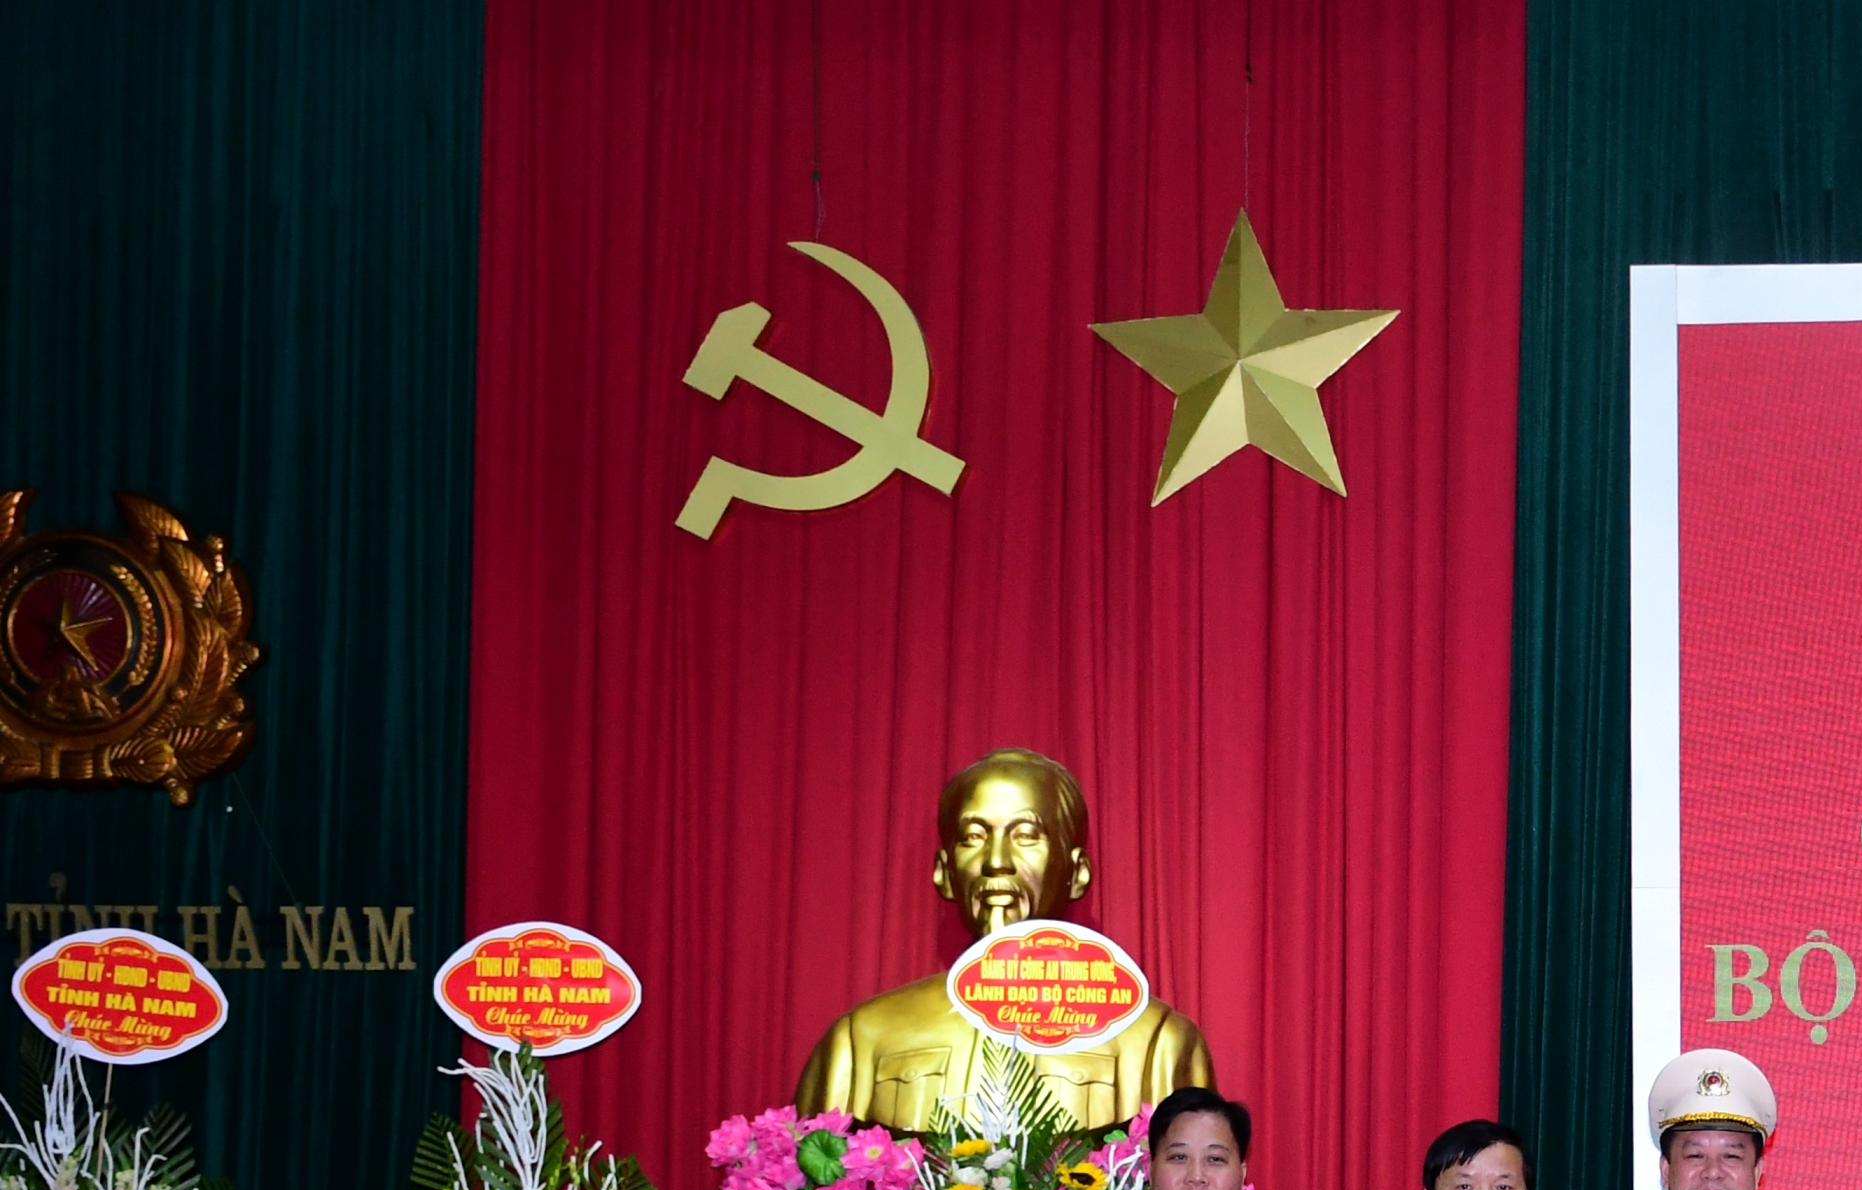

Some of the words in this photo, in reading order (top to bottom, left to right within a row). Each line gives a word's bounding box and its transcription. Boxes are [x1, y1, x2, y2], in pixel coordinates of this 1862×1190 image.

[177, 885, 266, 969] HÀ
[280, 906, 416, 970] NAM
[1020, 956, 1045, 981] CÔNG
[1046, 959, 1060, 981] AN
[1061, 960, 1089, 982] TRUNG
[467, 981, 518, 1003] TỈNH
[523, 984, 553, 1003] HÀ
[559, 987, 611, 1004] NAM
[965, 984, 1004, 1002] LÃNH
[1007, 985, 1038, 1005] ĐẠO
[1042, 984, 1062, 1007] BỘ
[1065, 984, 1107, 1004] CÔNG
[1110, 988, 1132, 1005] AN
[1705, 929, 1857, 1044] BỘ
[105, 991, 136, 1012] HÀ
[142, 997, 197, 1018] NAM
[997, 1004, 1041, 1025] Chúc
[1043, 1005, 1097, 1028] Mừng
[65, 1009, 112, 1031] Chúc
[116, 1016, 172, 1042] Mừng
[486, 1006, 531, 1025] Chúc
[533, 1007, 589, 1030] Mừng
